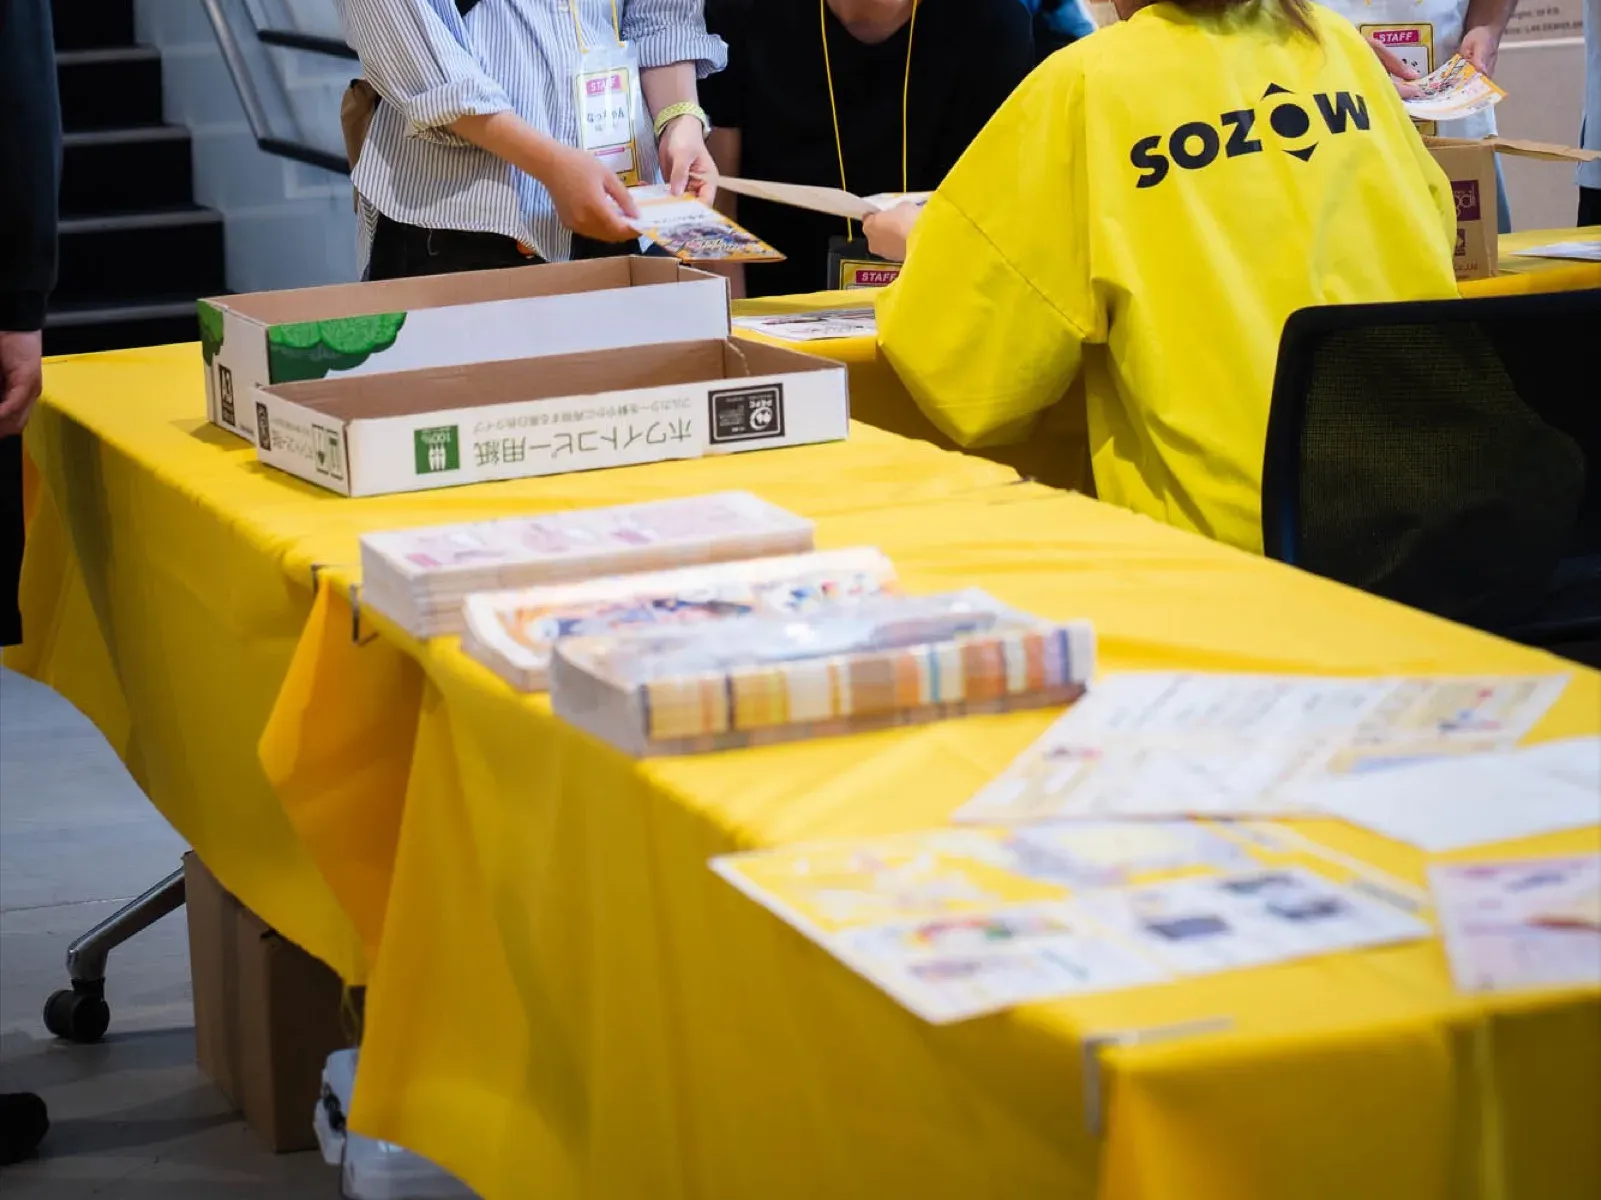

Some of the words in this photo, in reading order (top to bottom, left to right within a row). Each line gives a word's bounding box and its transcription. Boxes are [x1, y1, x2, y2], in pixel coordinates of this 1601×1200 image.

[1379, 31, 1413, 43] STAFF
[1130, 82, 1370, 188] SOZOW
[861, 271, 898, 282] STAFF
[473, 417, 692, 467] ホワイトコピー用紙
